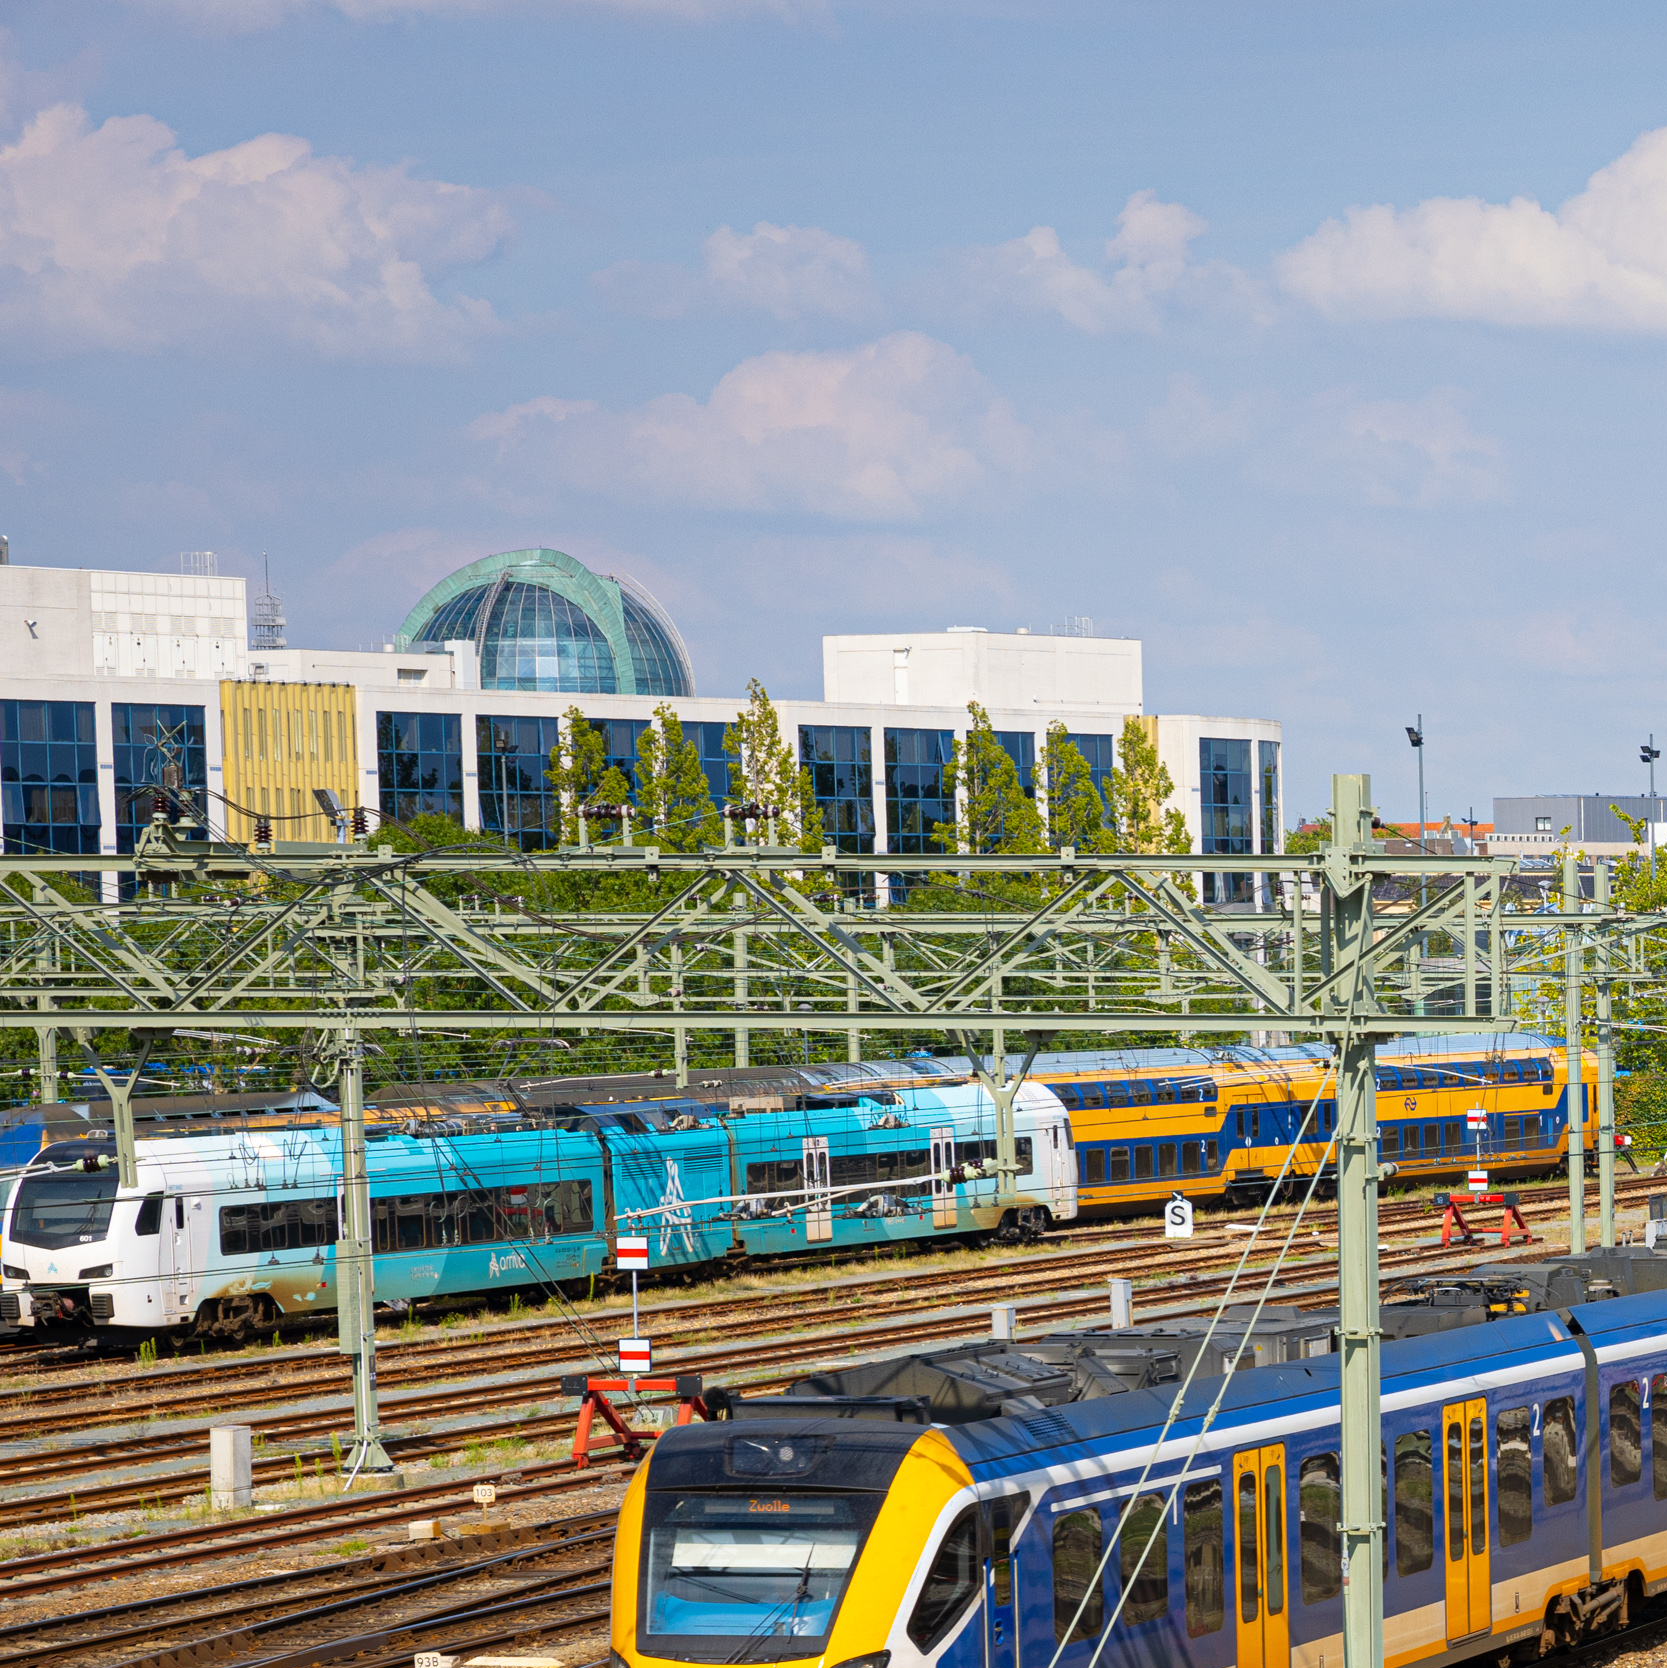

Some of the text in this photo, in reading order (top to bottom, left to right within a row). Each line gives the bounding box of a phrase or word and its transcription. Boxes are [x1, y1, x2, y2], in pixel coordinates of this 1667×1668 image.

[1376, 1078, 1381, 1091] 2
[1199, 1088, 1204, 1101] 2
[1201, 1139, 1206, 1153] 2
[1170, 1205, 1186, 1226] S
[1642, 1377, 1650, 1409] 2
[1533, 1403, 1541, 1436] 2
[476, 1488, 493, 1498] 103
[749, 1500, 790, 1512] Zwolle
[416, 1656, 439, 1668] 93B
